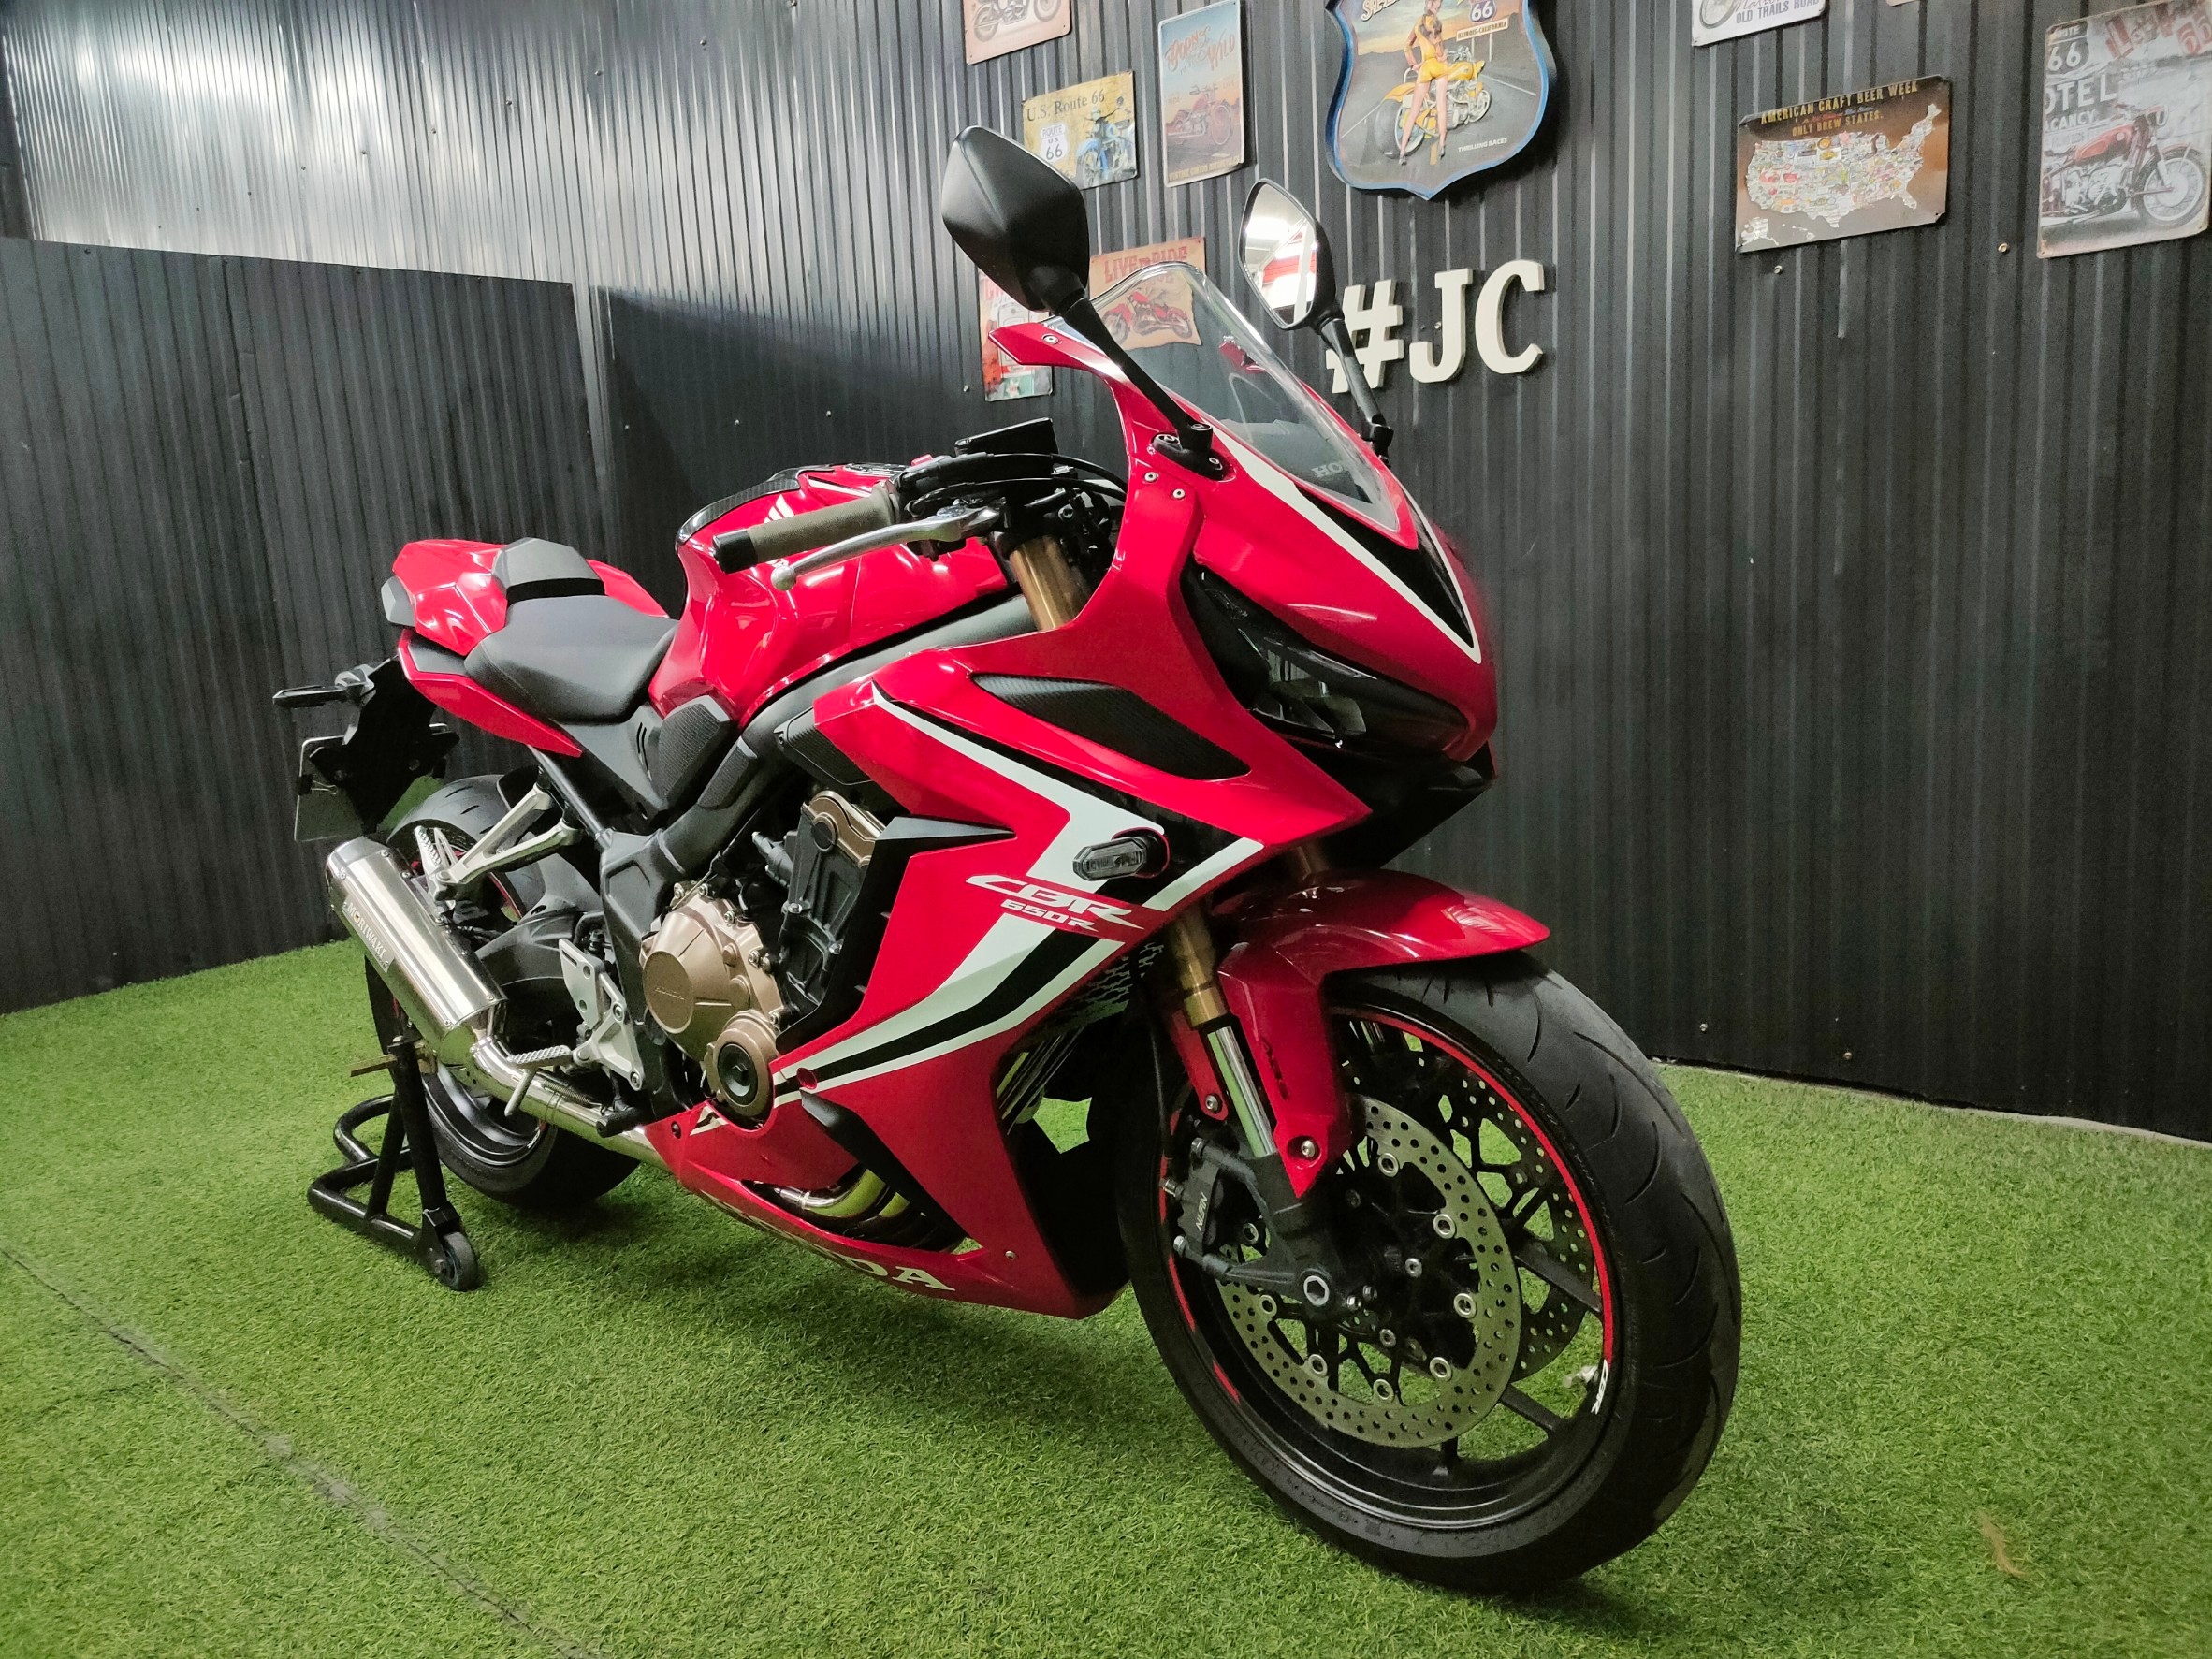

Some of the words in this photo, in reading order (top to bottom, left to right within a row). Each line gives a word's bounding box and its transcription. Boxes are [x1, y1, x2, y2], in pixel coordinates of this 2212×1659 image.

[1471, 1, 1494, 22] 66
[1736, 10, 1754, 23] OLD
[1758, 1, 1789, 19] TRAILS
[2047, 41, 2082, 71] 66
[1026, 105, 1050, 122] U.S.
[1055, 95, 1088, 115] Route
[1091, 89, 1105, 105] 66
[1761, 102, 1814, 124] AMERICAN
[1818, 95, 1851, 111] CRAFT
[1856, 88, 1883, 104] BEER
[1887, 80, 1917, 97] WEEK
[1042, 124, 1063, 137] ROUTE
[1792, 123, 1813, 137] ONLY
[1816, 118, 1841, 132] BREW
[1046, 144, 1063, 160] 66
[966, 875, 1144, 929] CBR
[1001, 899, 1099, 932] 650R
[346, 901, 386, 959] MORIWAKI
[1196, 1191, 1208, 1232] NISSIN
